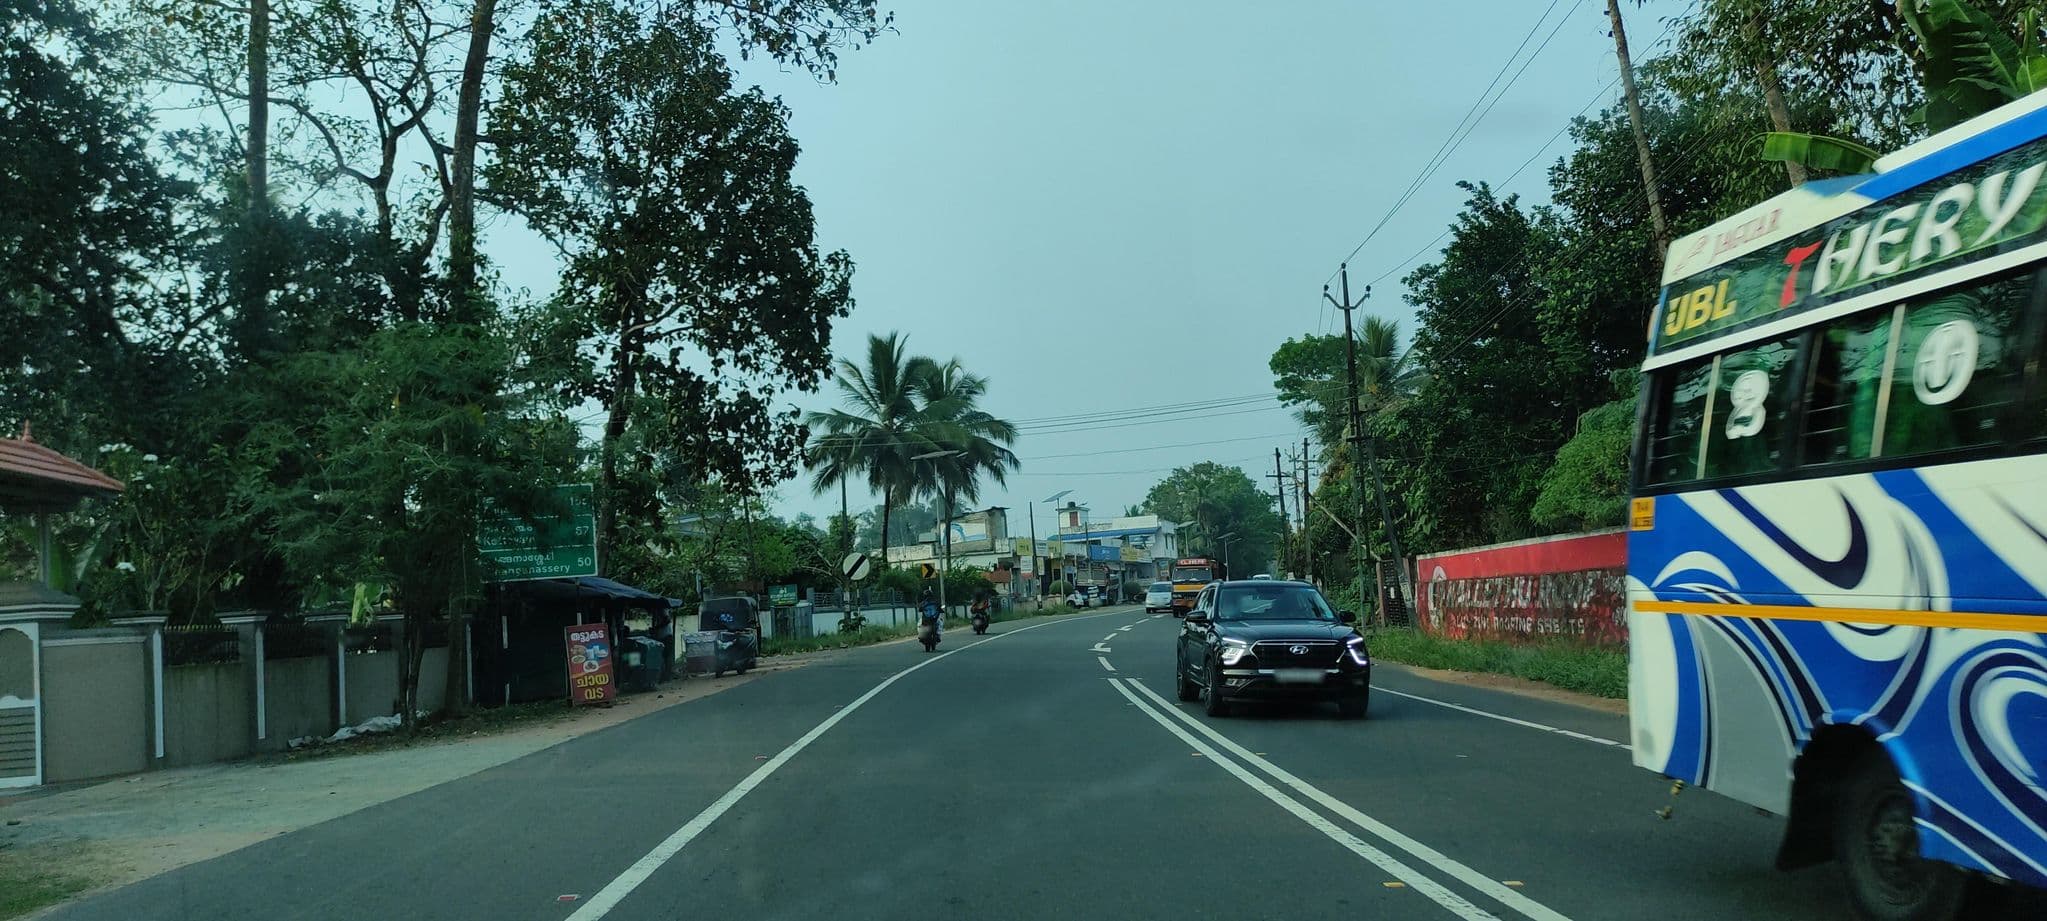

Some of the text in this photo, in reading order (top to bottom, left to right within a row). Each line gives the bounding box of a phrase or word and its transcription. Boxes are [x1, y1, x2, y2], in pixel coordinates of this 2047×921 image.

[1665, 278, 1737, 337] JBL
[575, 526, 591, 537] 57
[577, 557, 593, 568] 50
[1538, 616, 1584, 635] SHETS
[571, 630, 605, 643] തട്ടുകട
[577, 673, 609, 688] ചായ
[584, 687, 604, 700] വട
